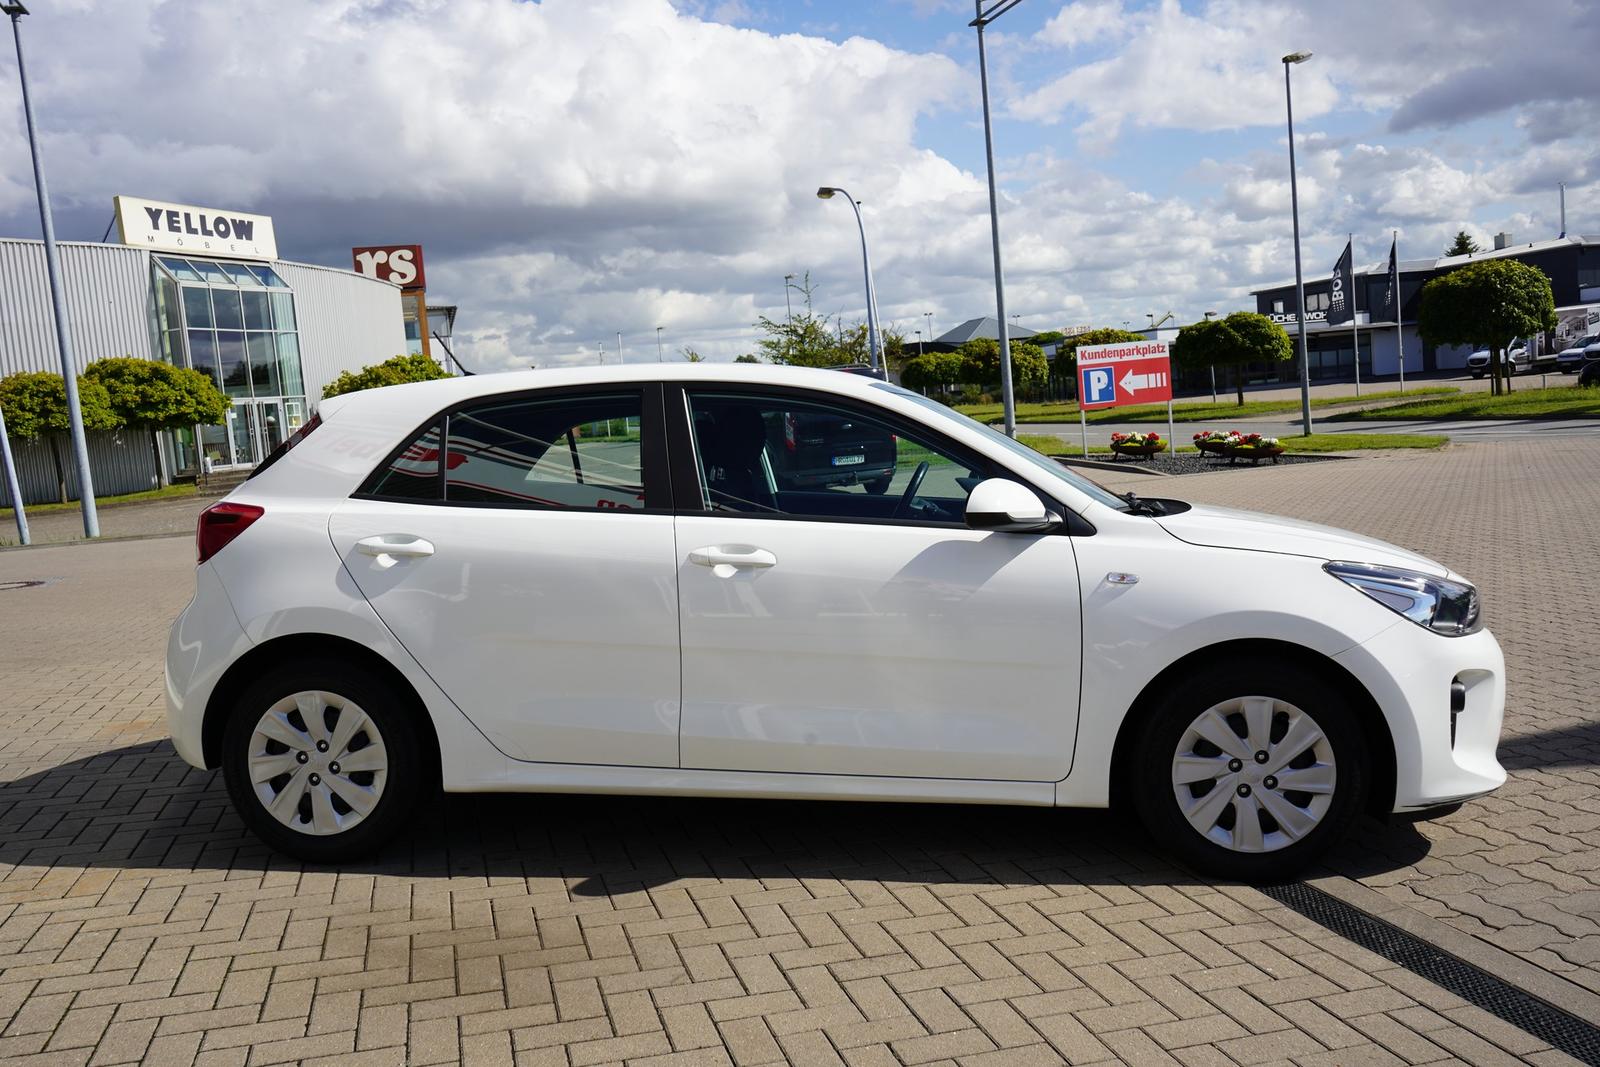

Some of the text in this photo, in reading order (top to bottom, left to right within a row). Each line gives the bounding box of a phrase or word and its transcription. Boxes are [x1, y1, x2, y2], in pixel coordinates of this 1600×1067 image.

[144, 206, 254, 241] YELLOW
[147, 235, 260, 254] MÖBEL
[1265, 313, 1297, 323] ÜCHE
[1080, 343, 1166, 361] Kundenparkplatz
[1089, 370, 1109, 401] P
